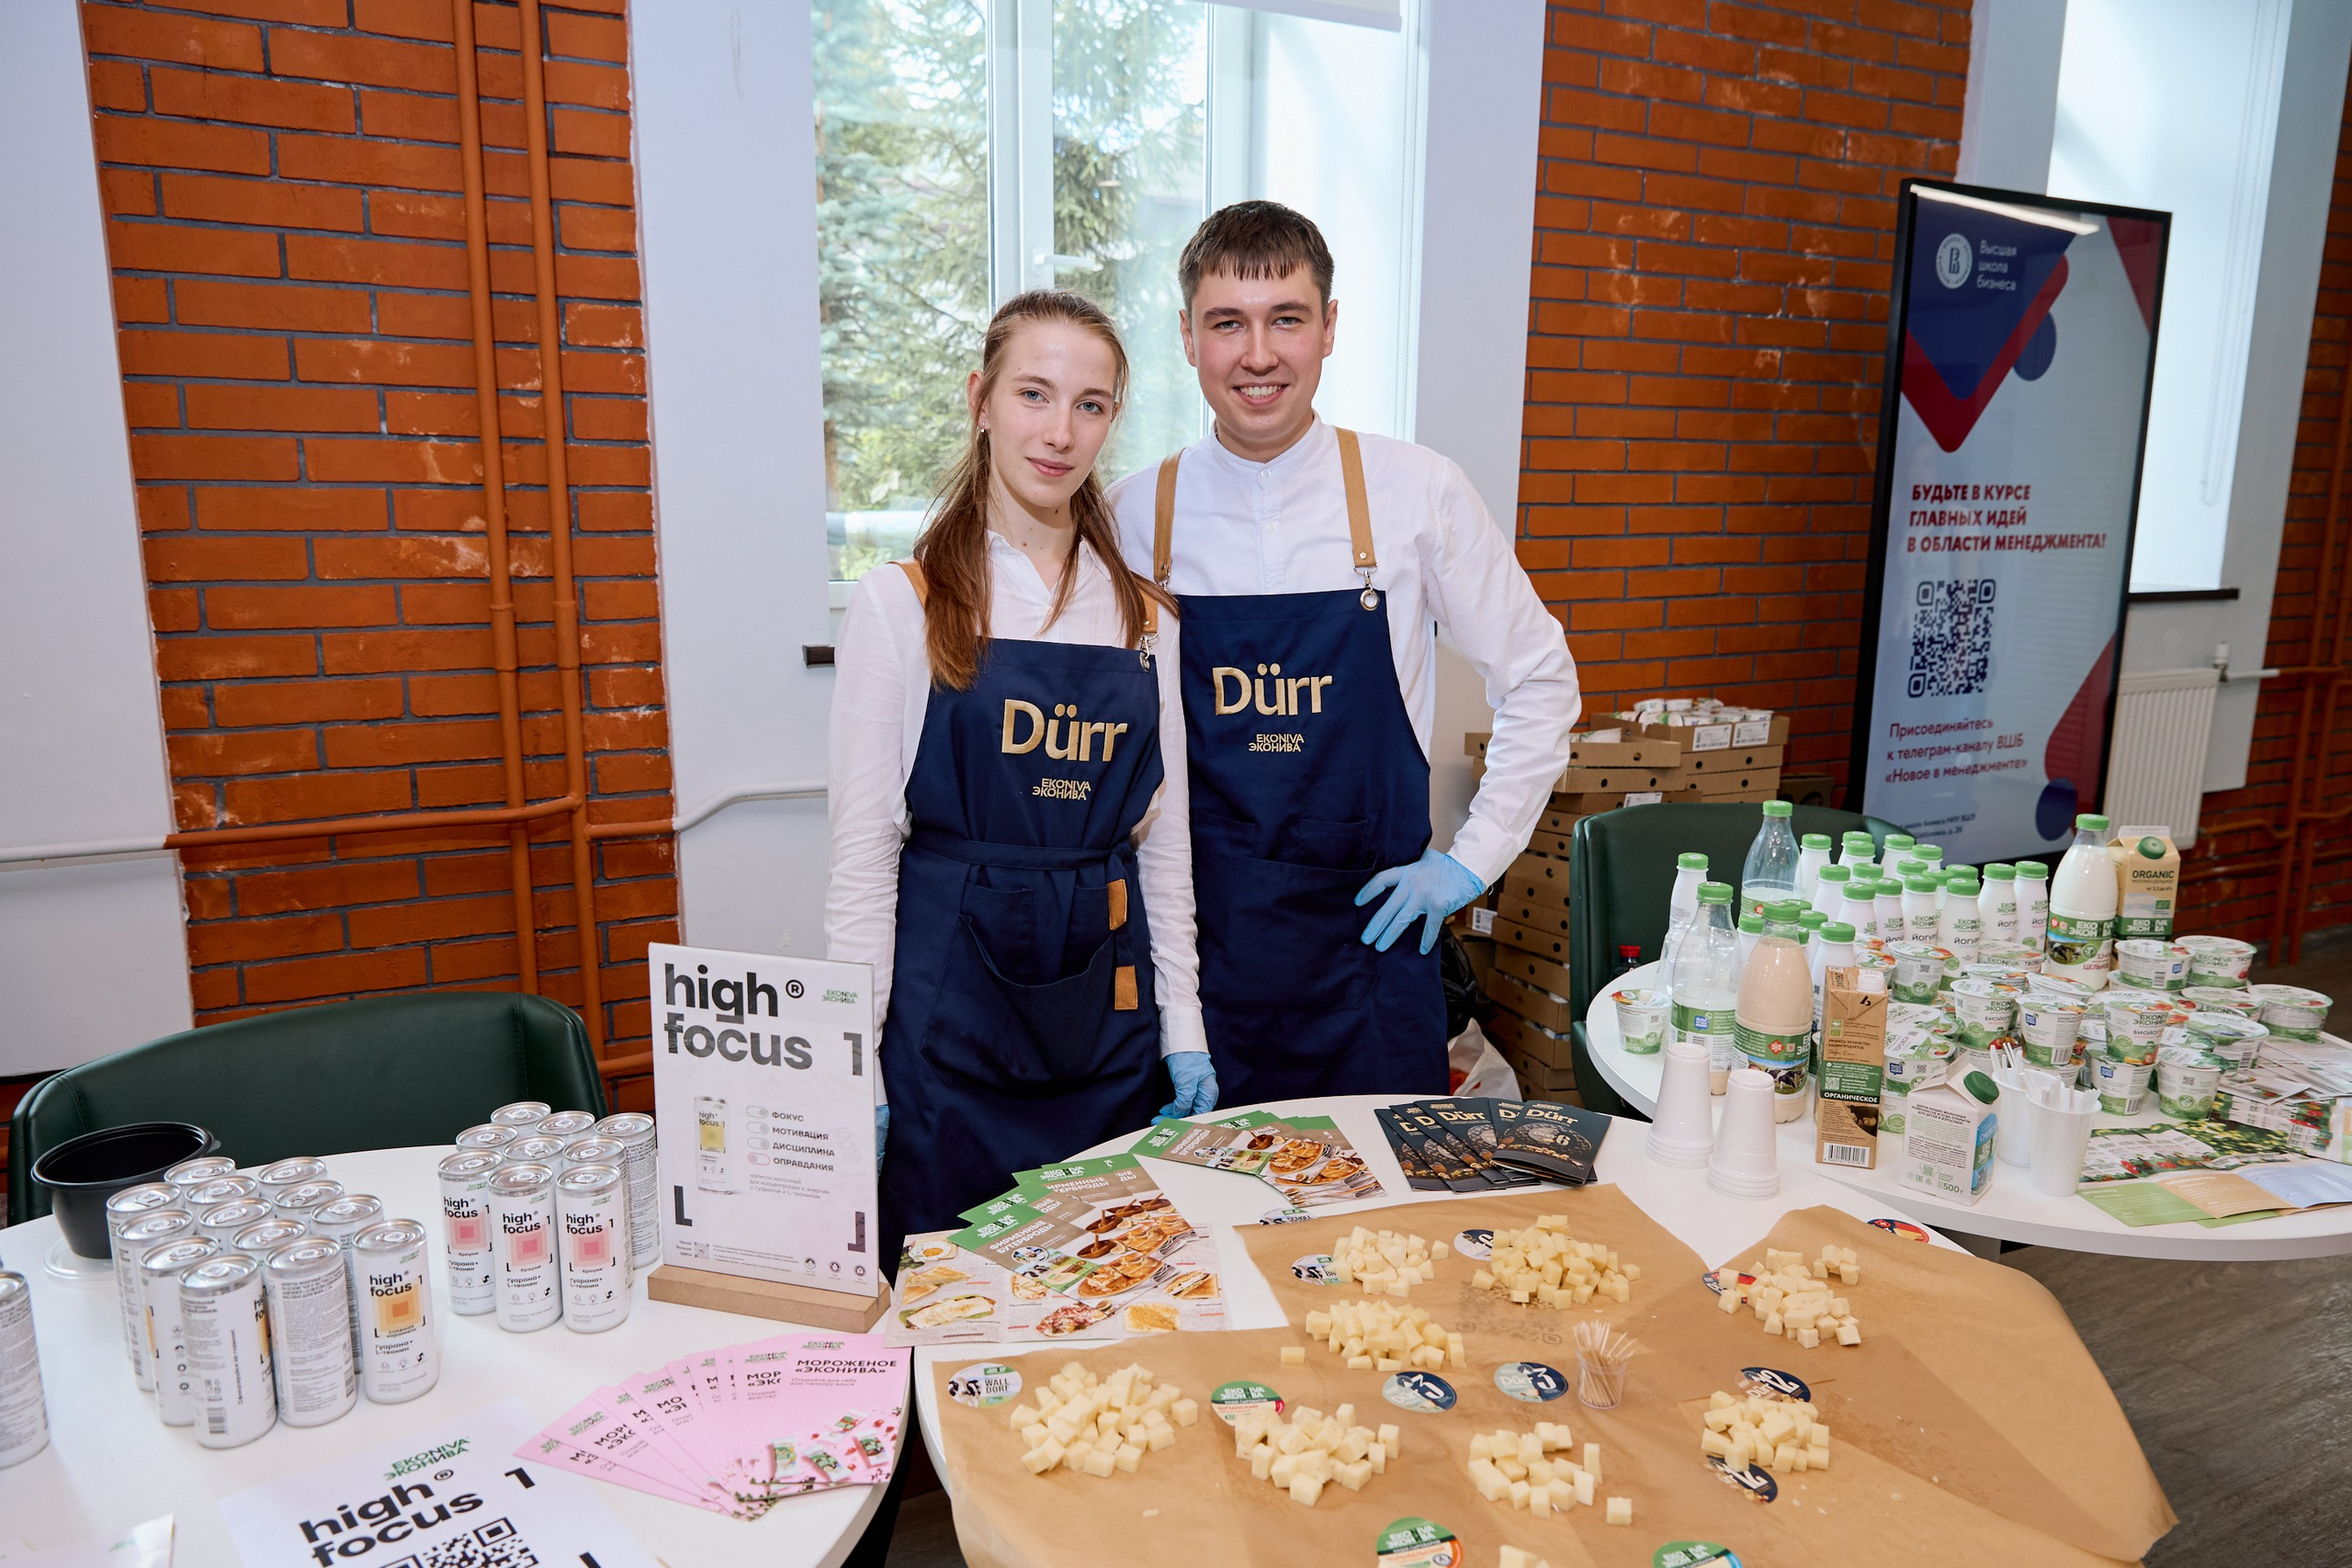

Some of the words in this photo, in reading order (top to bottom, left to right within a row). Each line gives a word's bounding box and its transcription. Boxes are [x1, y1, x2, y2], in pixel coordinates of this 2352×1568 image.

[1980, 239, 2017, 256] Высшая
[1978, 261, 2008, 273] школа
[1976, 275, 2016, 290] бизнеса
[1912, 484, 1968, 502] БУДЬТЕ
[1972, 485, 1980, 500] В
[1984, 485, 2030, 500] КУРСЕ
[1909, 511, 1981, 526] ГЛАВНЫХ
[1985, 506, 2027, 528] ИДЕЙ
[1906, 536, 1916, 552] В
[1920, 536, 1991, 552] ОБЛАСТИ
[1995, 534, 2107, 552] МЕНЕДЖМЕНТА!
[1212, 663, 1333, 716] Dürr
[1001, 699, 1127, 761] Dürr
[1889, 717, 1994, 741] Присоединяйтесь
[1256, 734, 1305, 744] EKONIVA
[1249, 742, 1302, 753] ЭКОНИВА
[1887, 750, 1894, 761] к
[1897, 739, 1994, 761] телеграм-каналу
[1996, 733, 2024, 750] ВШБ
[1885, 768, 1930, 784] «Новое
[1934, 769, 1939, 778] в
[1942, 759, 2028, 778] менеджменте»
[1042, 778, 1091, 793] EKONIVA
[1033, 786, 1087, 801] ЭКОНИВА
[2132, 871, 2175, 879] ORGANIC
[664, 963, 778, 1024] high
[822, 995, 855, 1005] ЭКОНИВА
[827, 989, 858, 999] EKONIVA
[664, 1012, 813, 1070] focus
[1824, 1092, 1878, 1103] ОРГАНИЧЕСКОЕ
[772, 1111, 805, 1122] ФОКУС
[1437, 1111, 1486, 1121] Dürr
[1526, 1109, 1578, 1124] Dürr
[772, 1127, 829, 1141] МОТИВАЦИЯ
[773, 1142, 835, 1156] ДИСЦИПЛИНА
[774, 1157, 834, 1172] ОПРАВДАНИЯ
[1943, 1182, 1960, 1193] 500
[444, 1196, 469, 1210] high
[444, 1207, 478, 1218] focus
[503, 1213, 532, 1226] high
[566, 1213, 594, 1226] high
[503, 1223, 541, 1234] focus
[567, 1224, 603, 1235] focus
[989, 1220, 1047, 1250] ФИРМЕННЫЕ
[996, 1223, 1056, 1254] БУТЕРБРОДЫ
[370, 1273, 402, 1287] high
[370, 1282, 412, 1297] focus
[985, 1378, 1009, 1386] WALL
[986, 1384, 1009, 1393] DORF
[392, 1437, 469, 1470] EKONIVA
[384, 1447, 469, 1481] ЭКОНИВА
[299, 1479, 435, 1543] high
[311, 1493, 483, 1567] focus
